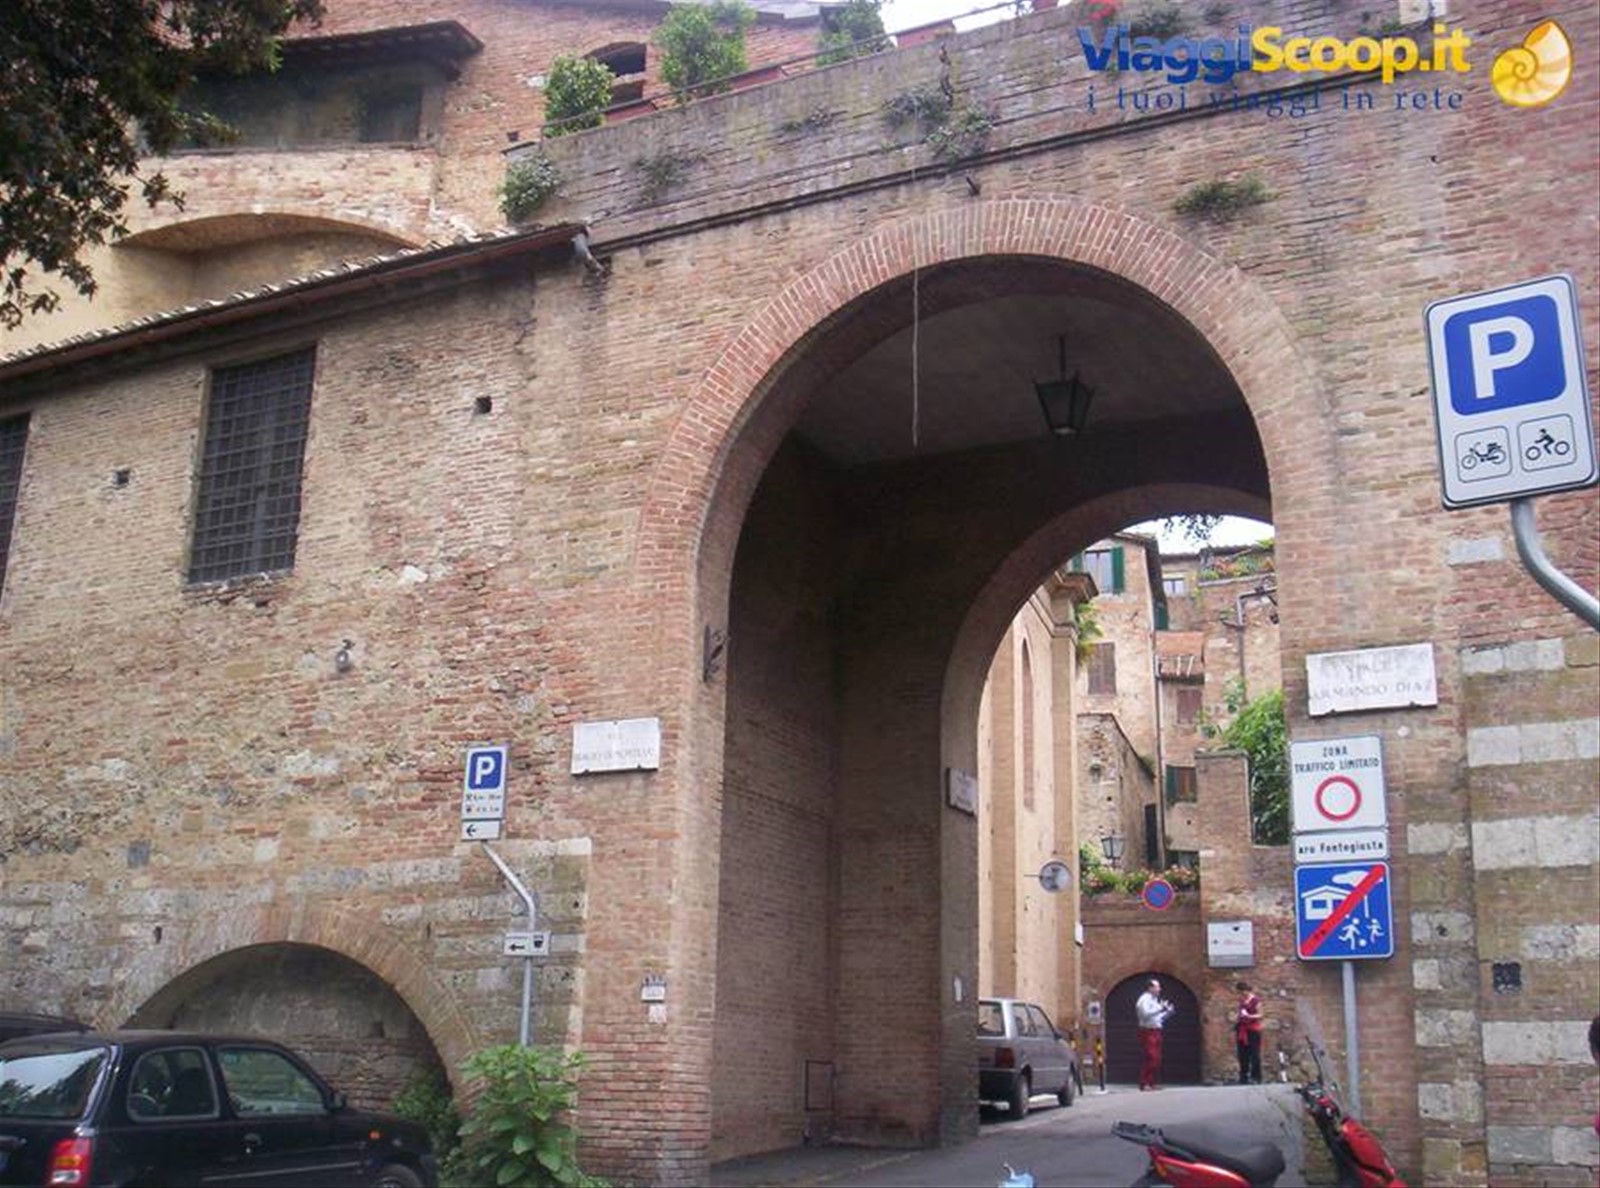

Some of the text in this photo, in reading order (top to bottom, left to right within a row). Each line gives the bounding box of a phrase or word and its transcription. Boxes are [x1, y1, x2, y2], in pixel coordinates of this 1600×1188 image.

[1468, 314, 1535, 399] P
[1322, 745, 1348, 757] ZONA
[474, 756, 495, 785] P
[1294, 757, 1380, 773] TRAFFICO LIMITATO
